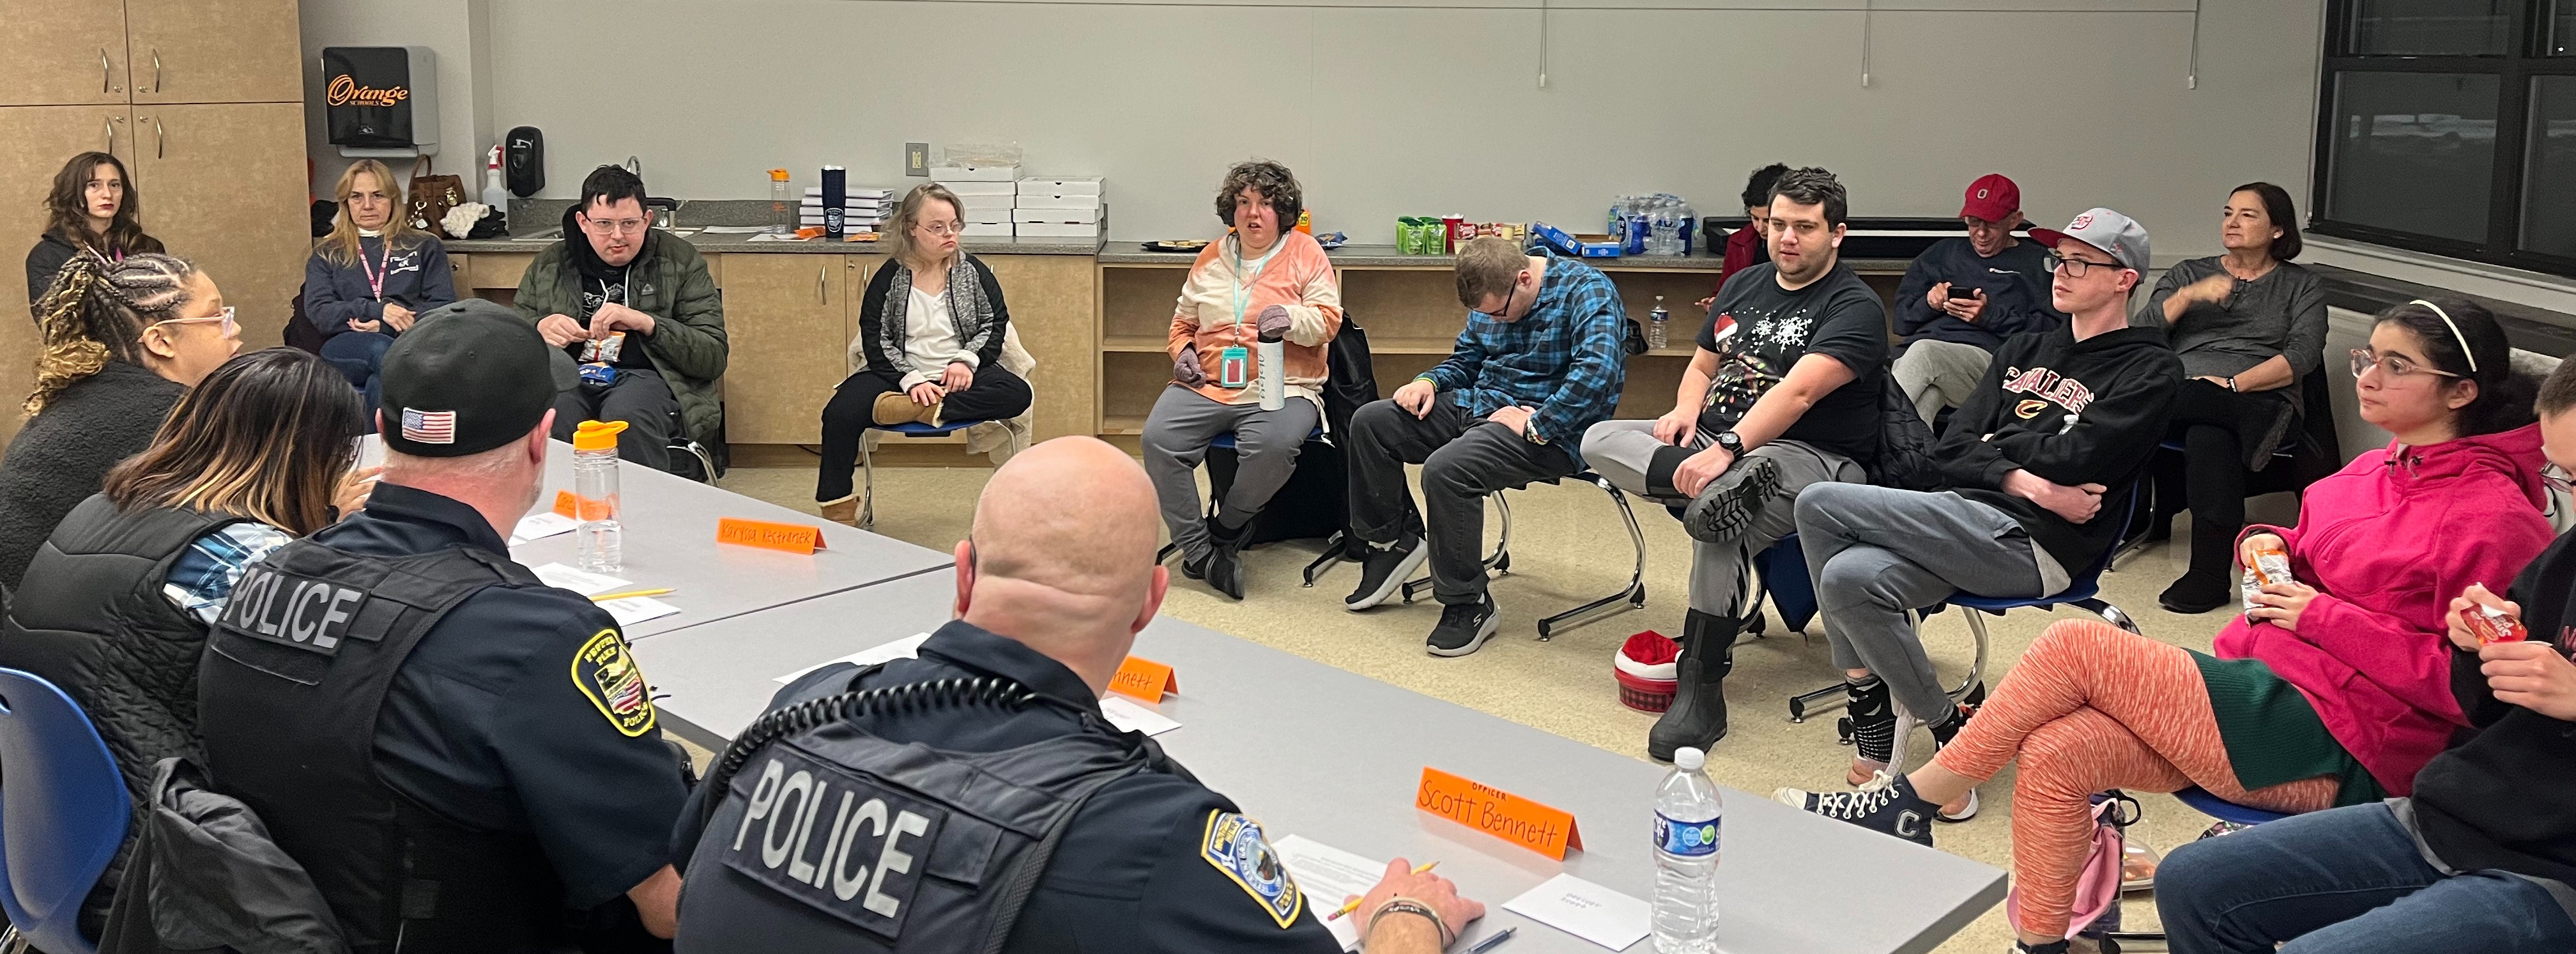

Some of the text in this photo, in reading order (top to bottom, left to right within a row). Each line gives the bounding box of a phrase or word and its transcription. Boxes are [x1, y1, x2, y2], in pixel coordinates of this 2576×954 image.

[328, 74, 408, 107] Orange
[1977, 188, 1988, 199] O
[2002, 366, 2095, 416] CAALIERS
[222, 567, 362, 649] POLICE
[1113, 671, 1153, 691] nnett
[1472, 782, 1506, 801] OFFICER
[1419, 780, 1558, 847] Scott Bennett
[1894, 809, 1922, 838] C
[733, 758, 930, 919] POLICE
